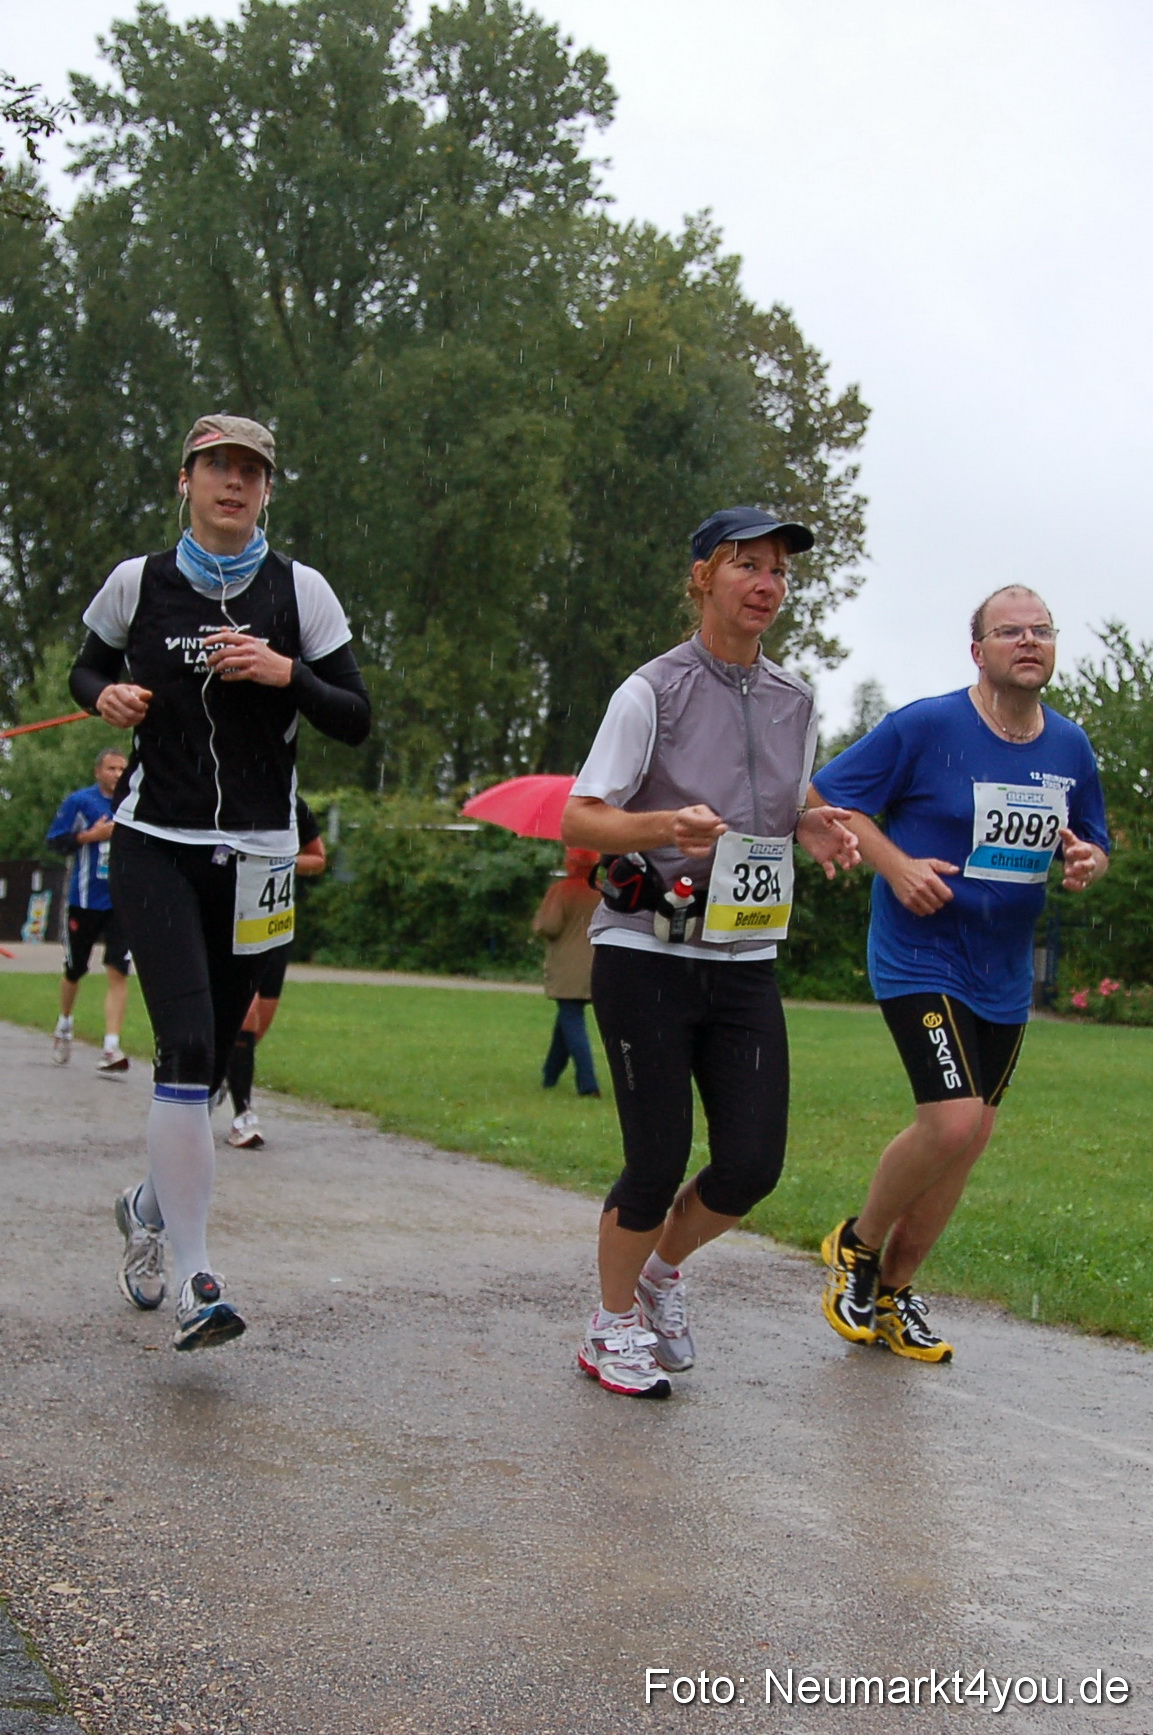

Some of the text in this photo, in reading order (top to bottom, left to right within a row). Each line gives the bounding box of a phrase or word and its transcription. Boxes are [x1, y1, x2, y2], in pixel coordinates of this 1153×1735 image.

[985, 809, 1060, 848] 3093
[258, 872, 291, 913] 44
[732, 863, 782, 903] 384
[735, 911, 771, 926] Bettina
[928, 1027, 962, 1090] SKINS
